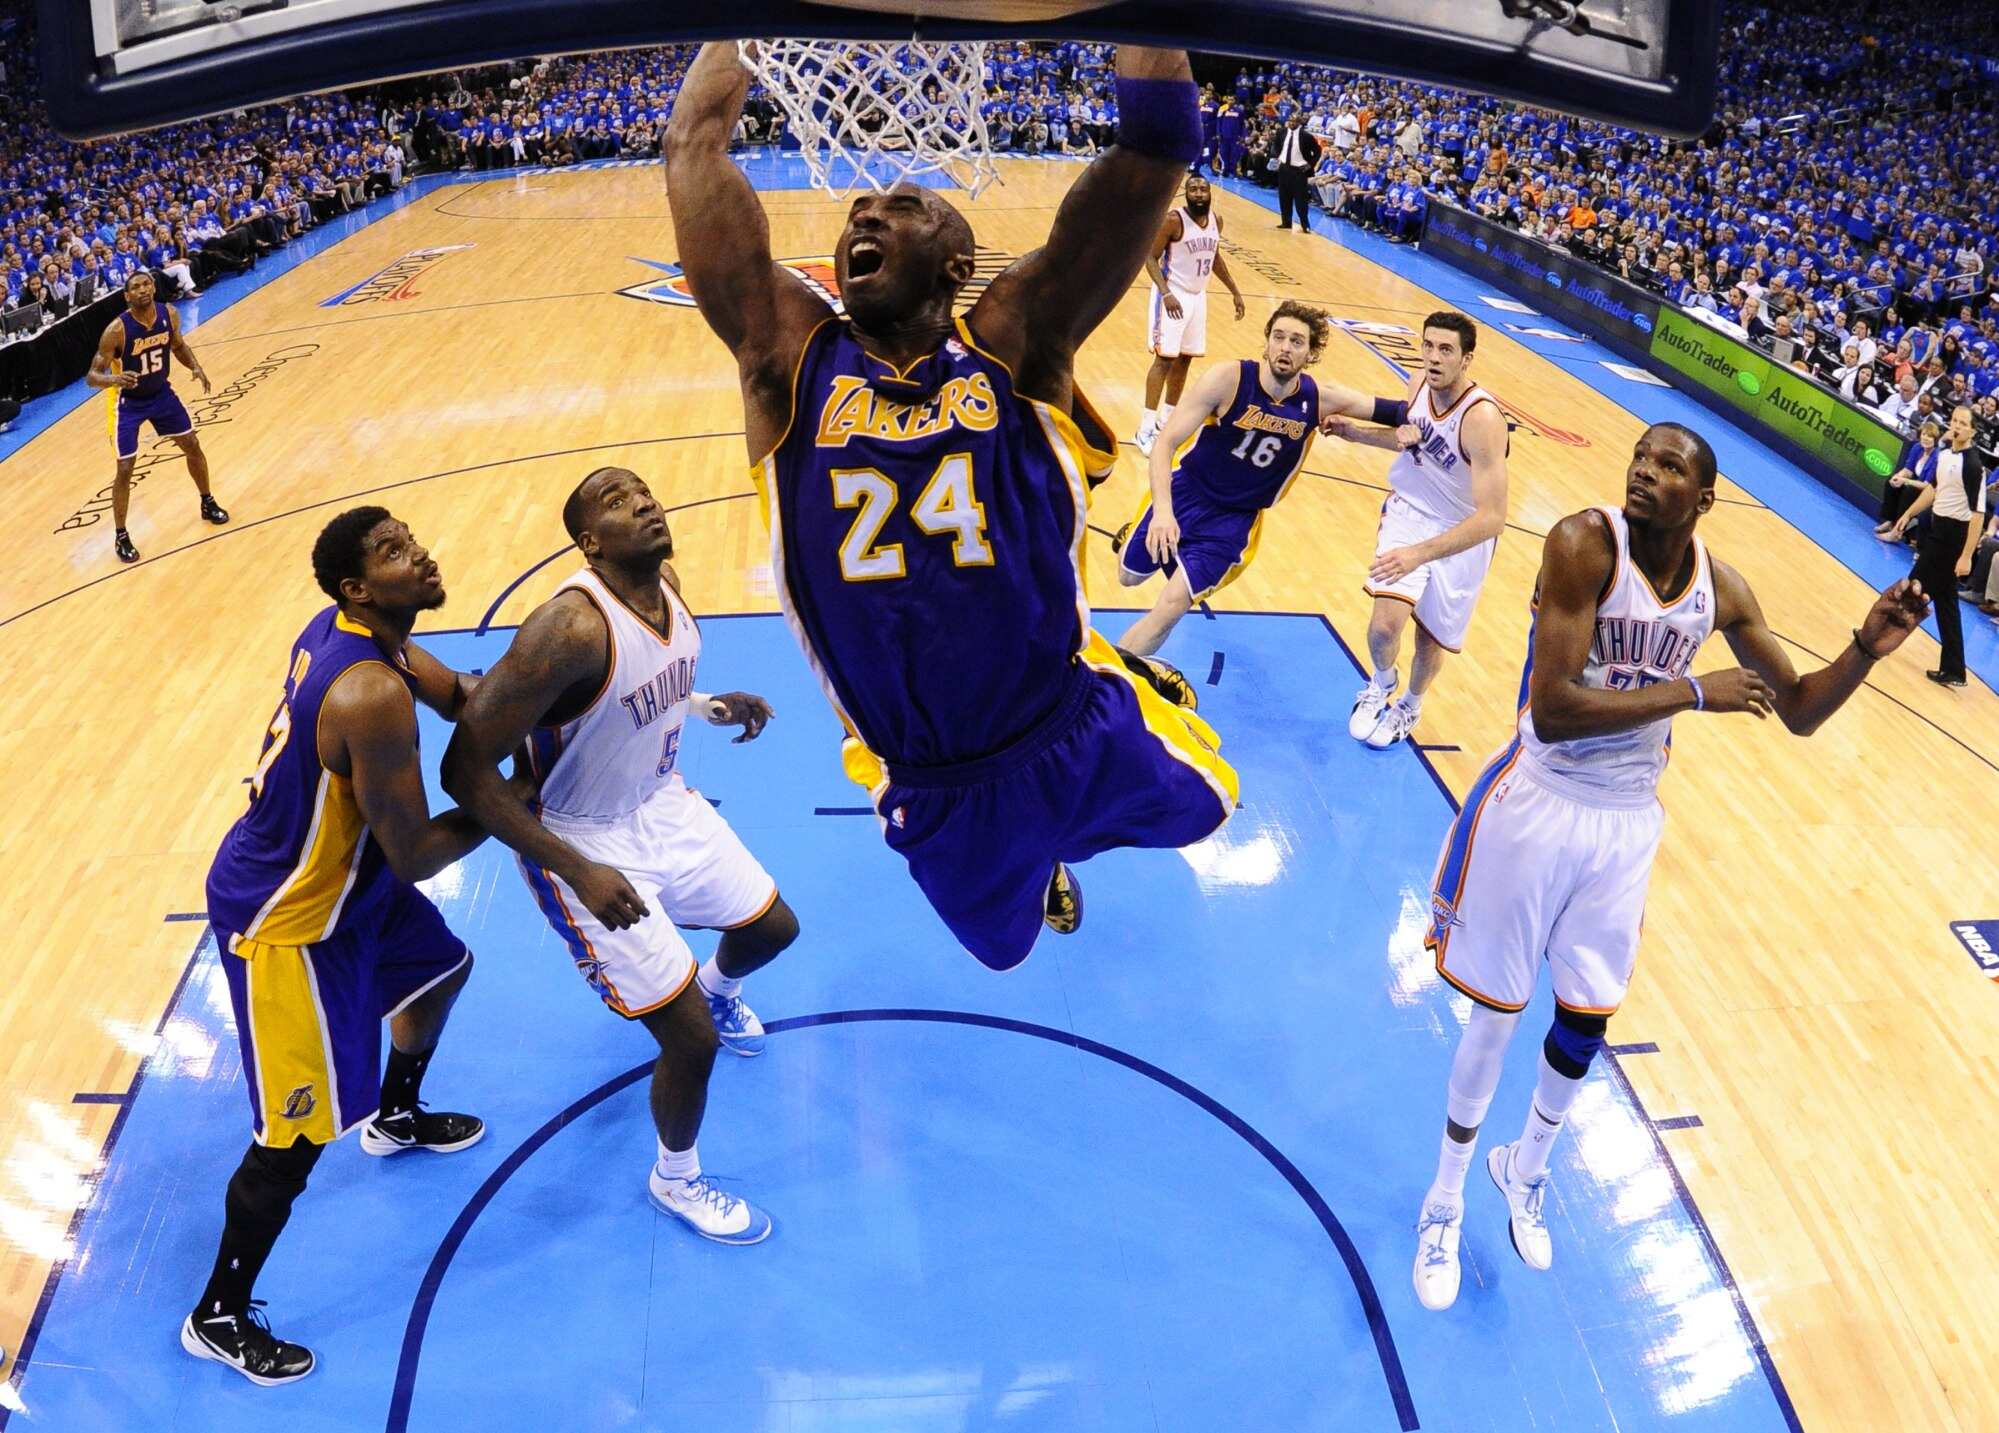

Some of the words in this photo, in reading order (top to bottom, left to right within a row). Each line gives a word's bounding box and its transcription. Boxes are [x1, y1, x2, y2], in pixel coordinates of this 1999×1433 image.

[1195, 258, 1211, 277] 13
[140, 348, 163, 376] 15
[1657, 324, 1740, 379] AutoTrader
[815, 372, 999, 448] LAKERS
[1232, 404, 1308, 441] LAKERS
[1766, 386, 1866, 456] AutoTrader
[1231, 430, 1283, 469] 16
[830, 452, 996, 582] 24
[656, 724, 683, 778] 5
[1955, 925, 1999, 967] NBA
